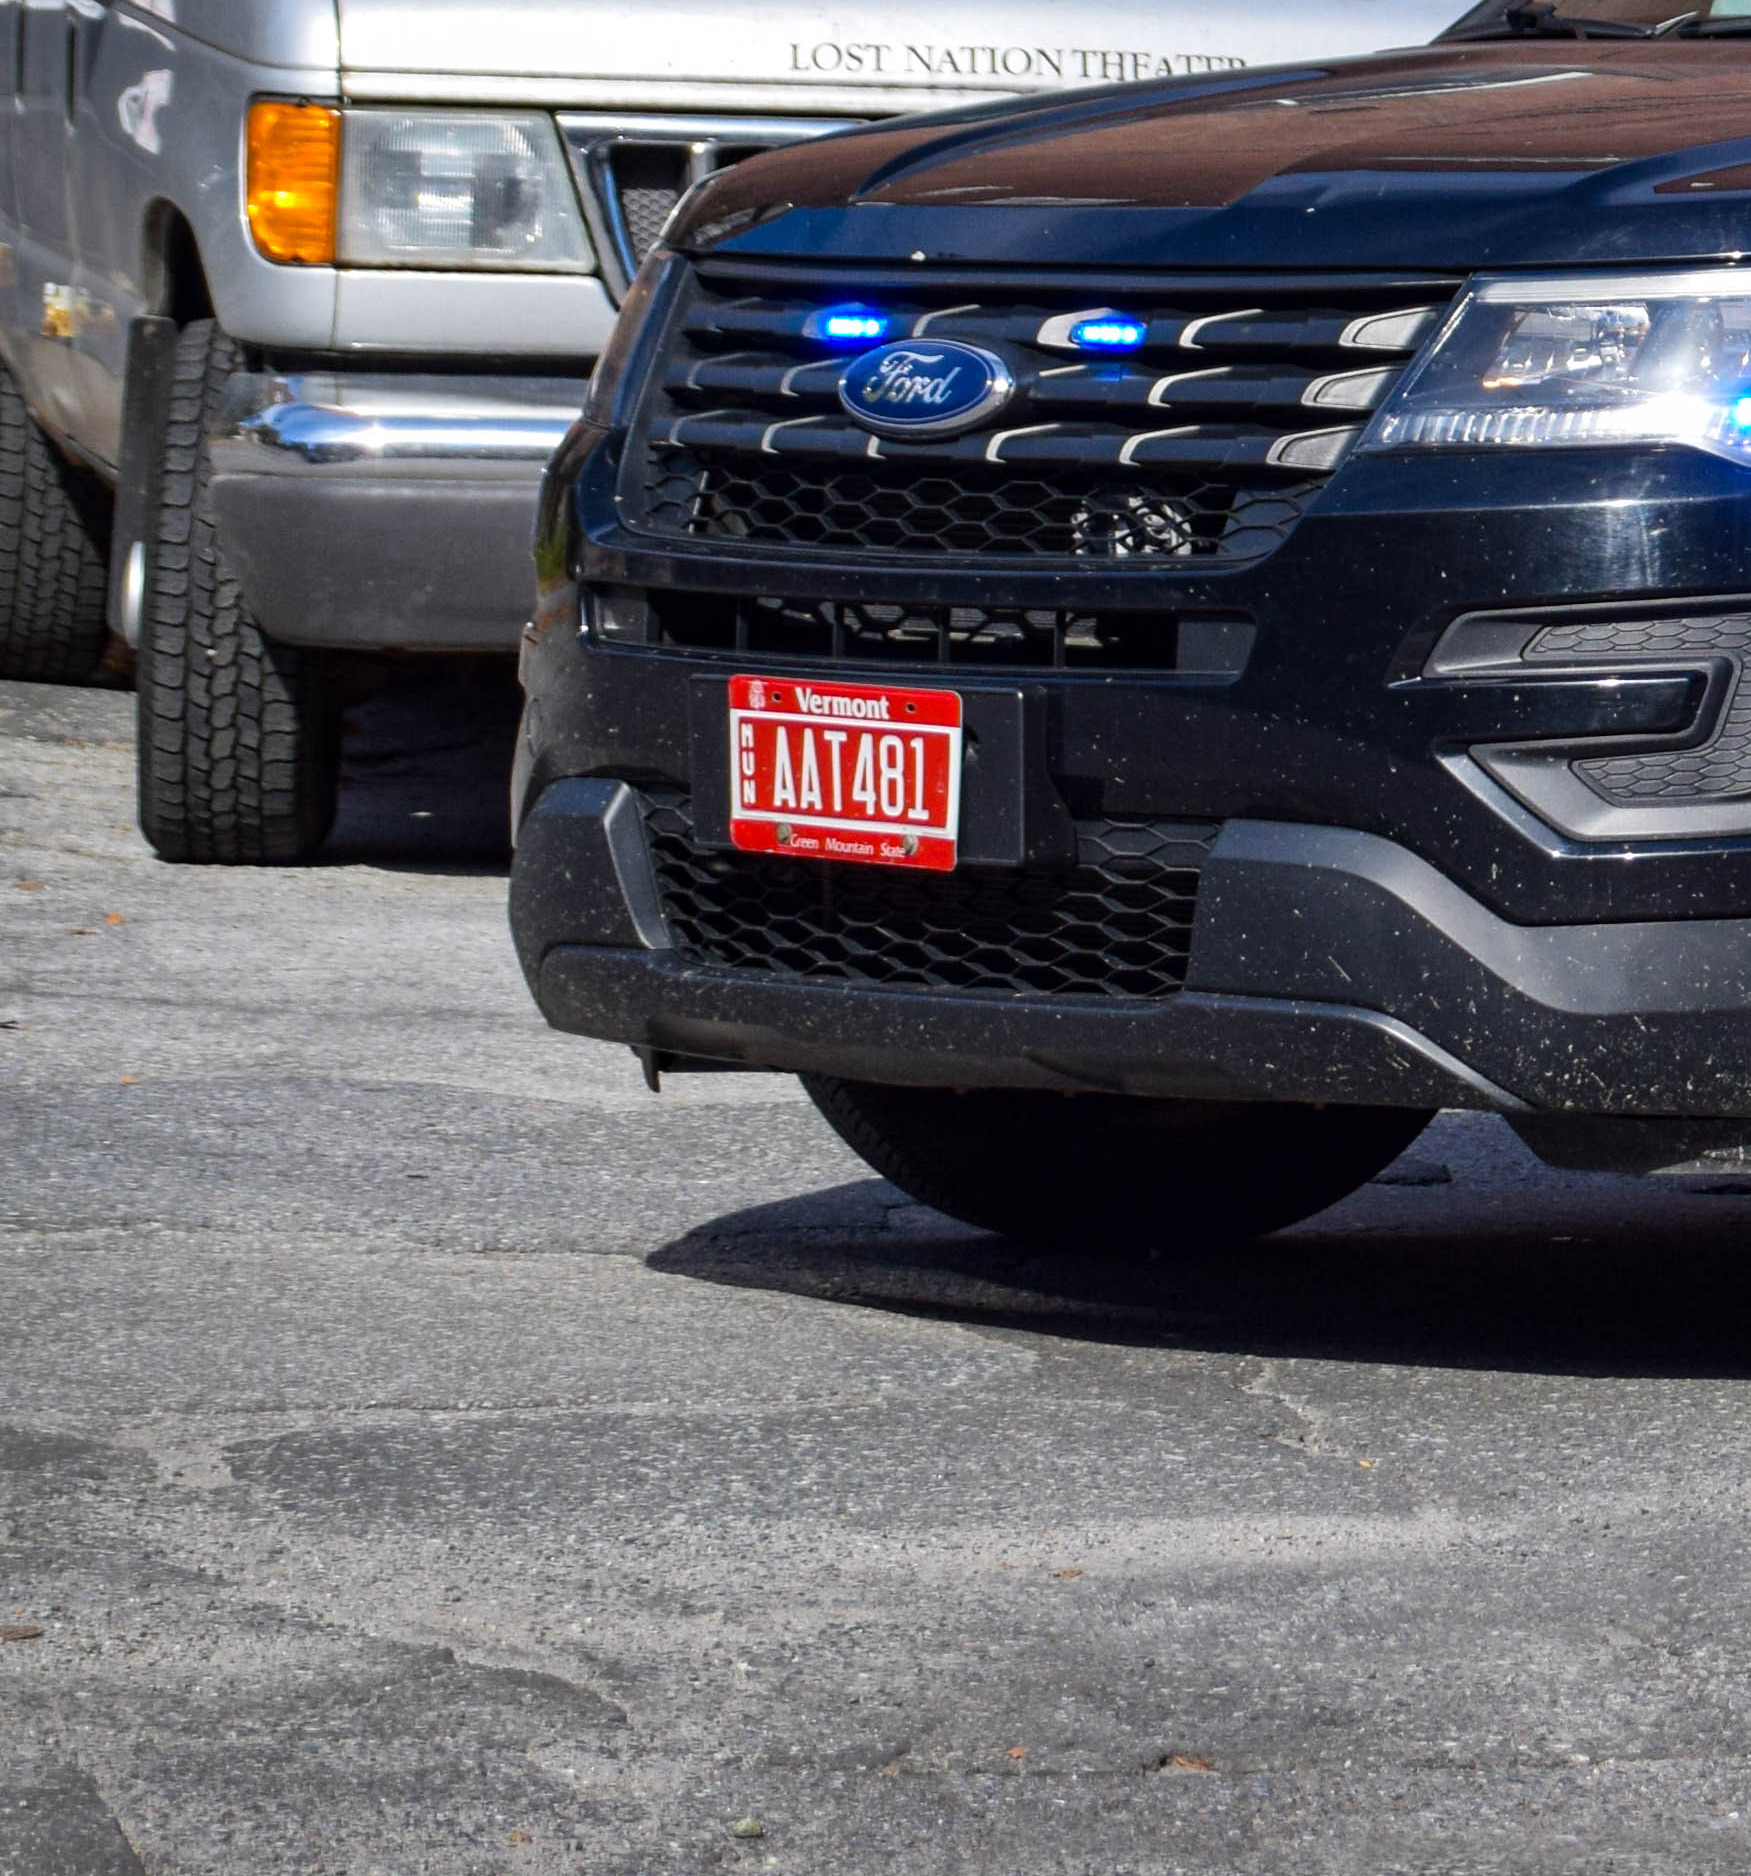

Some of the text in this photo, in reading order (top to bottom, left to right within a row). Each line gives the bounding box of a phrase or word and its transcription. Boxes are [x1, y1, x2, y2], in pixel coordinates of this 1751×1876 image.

[789, 42, 892, 73] LOST
[904, 44, 1063, 76] NATION
[862, 350, 961, 405] Ford
[795, 687, 890, 720] Vermont
[773, 725, 930, 821] AAT481
[790, 833, 906, 859] Green Mountain State
